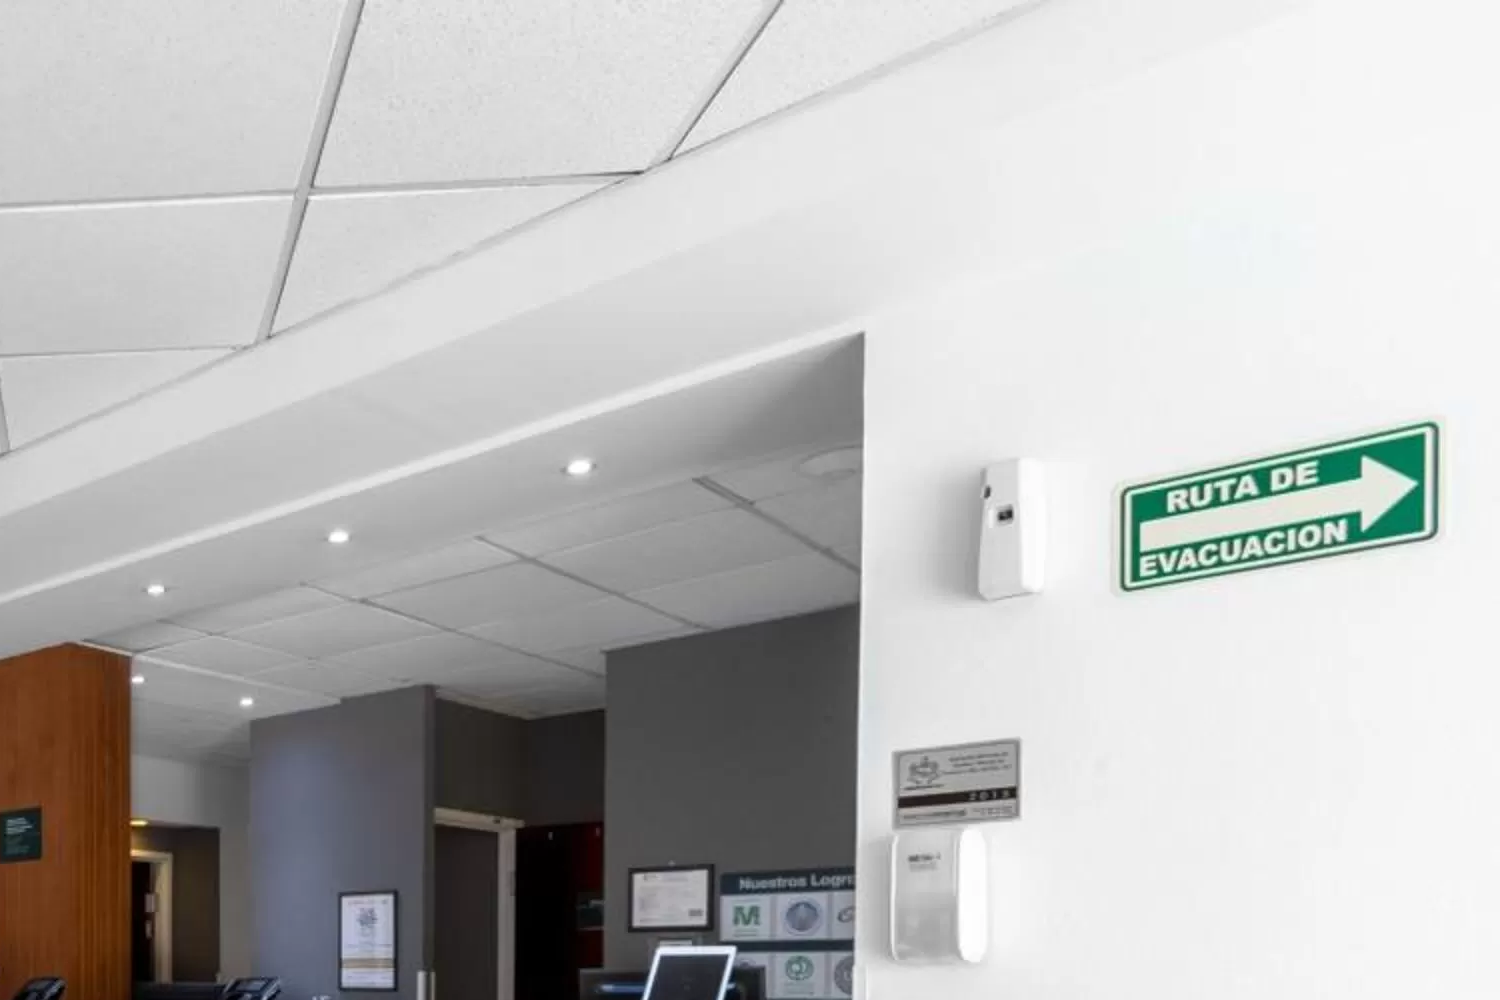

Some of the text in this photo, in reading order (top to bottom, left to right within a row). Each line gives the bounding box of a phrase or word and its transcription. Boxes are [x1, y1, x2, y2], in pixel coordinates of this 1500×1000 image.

[1166, 460, 1320, 514] RUTA DE
[1139, 518, 1348, 578] EVACUACION
[739, 875, 807, 891] Nuestros
